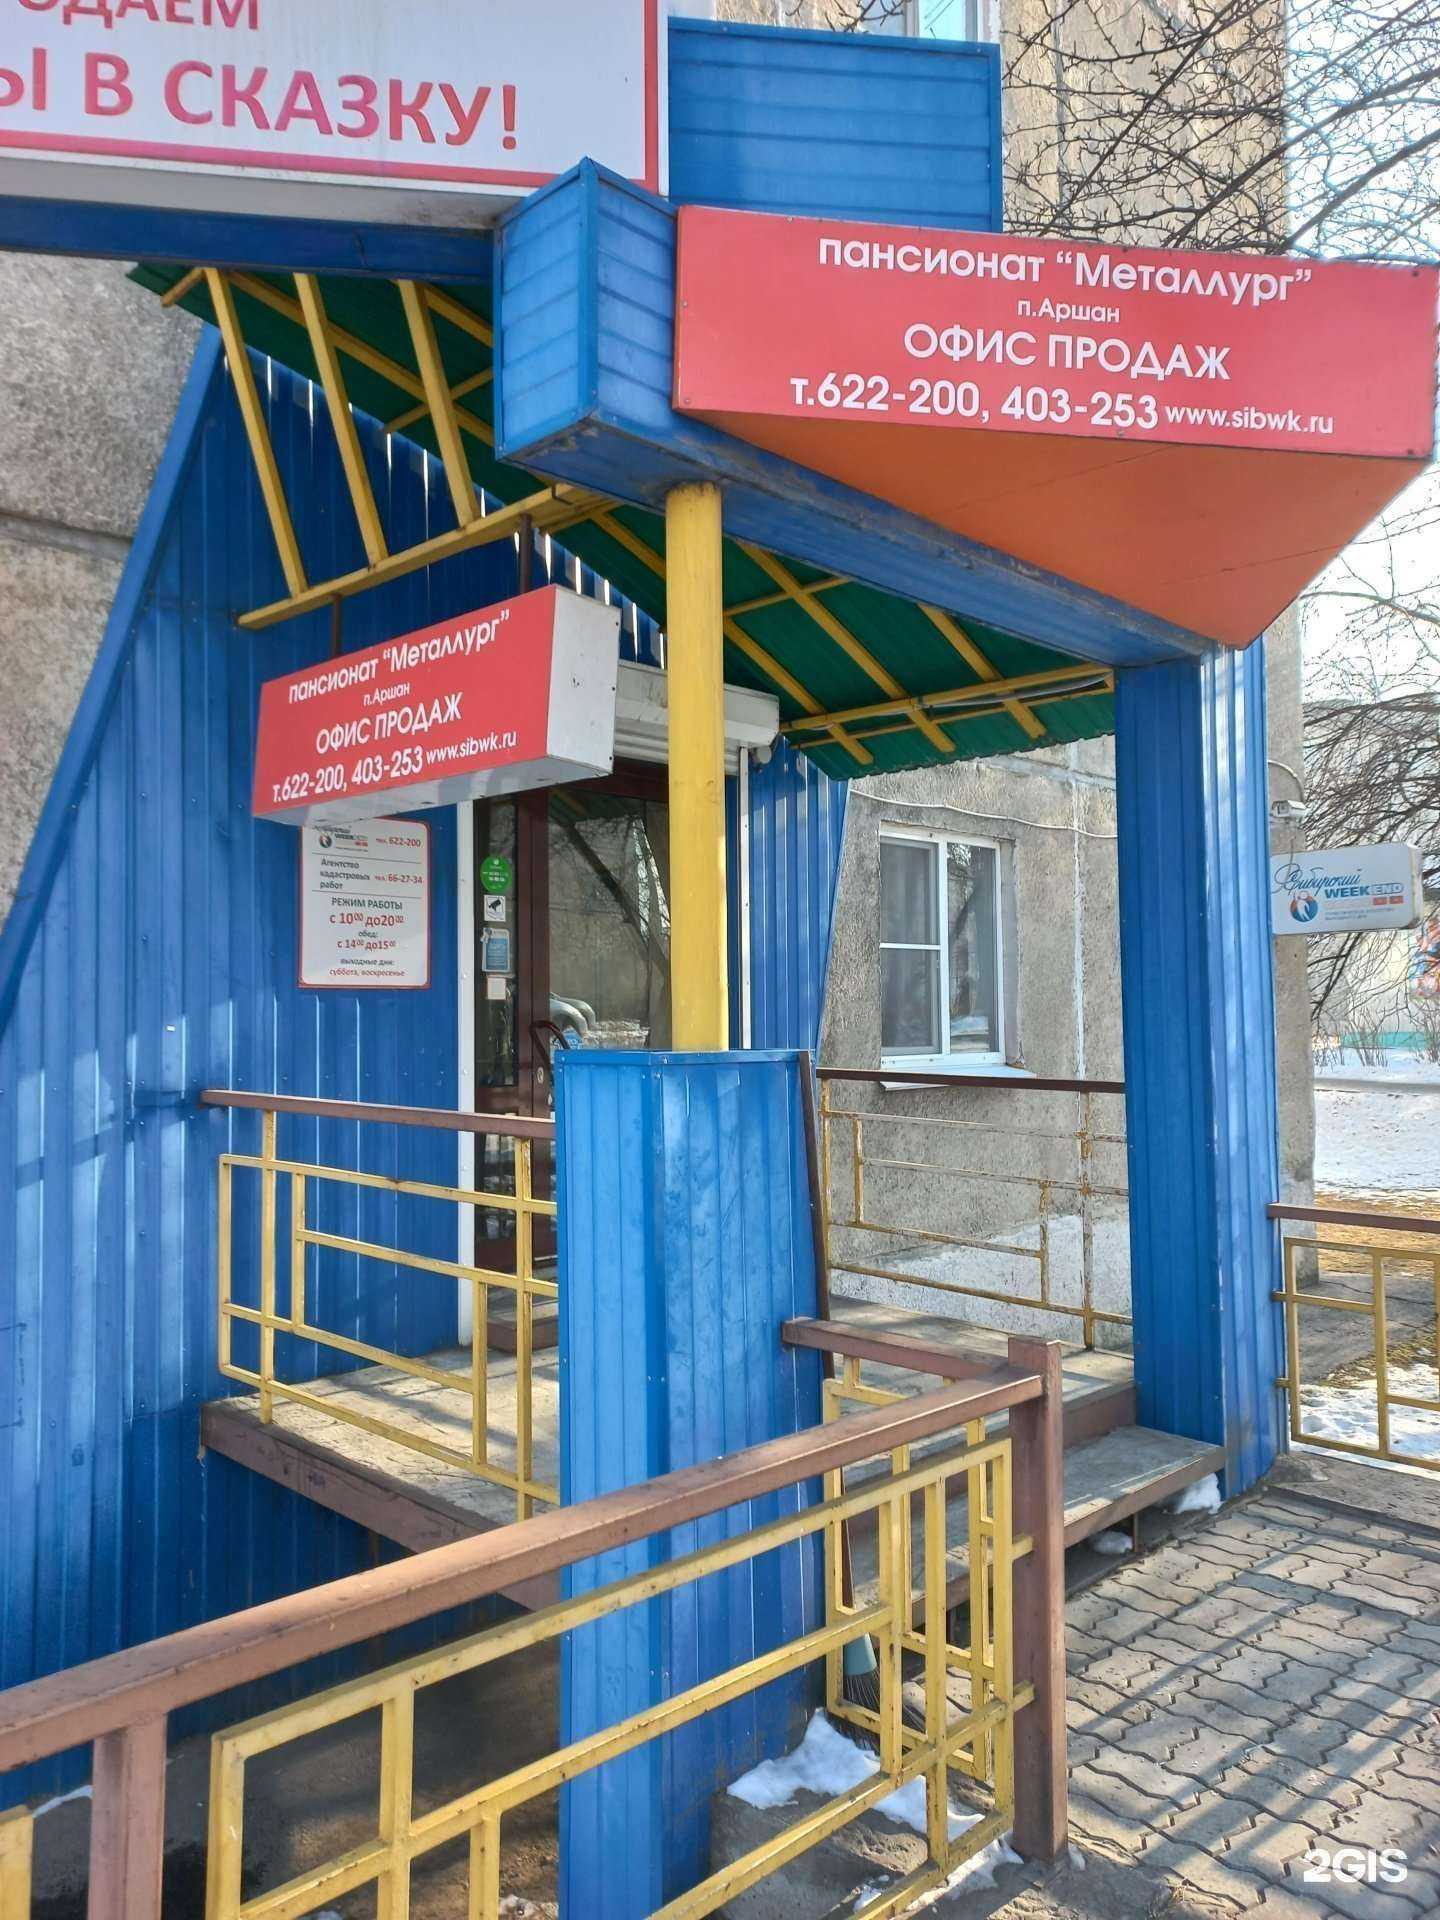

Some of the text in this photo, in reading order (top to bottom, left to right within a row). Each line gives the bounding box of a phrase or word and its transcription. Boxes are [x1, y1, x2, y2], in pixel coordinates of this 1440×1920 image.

[84, 52, 134, 117] В
[164, 60, 518, 151] СКАЗКУ!
[818, 237, 1046, 283] пансионат
[1017, 297, 1120, 323] п.Аршан
[904, 323, 1231, 382] ОФИС ПРОДАЖ
[789, 372, 1334, 435] т.622-200, 403-253 www.sibwk.ru
[288, 657, 379, 705] пансионат
[363, 681, 411, 707] п.Аршан
[315, 691, 463, 755] ОФИС ПРОДАЖ
[272, 729, 517, 804] т.622-200, 403-253 www.sibwk.ru
[389, 836, 421, 848] 622-200
[320, 870, 370, 881] кадастровых
[388, 873, 423, 885] 66-27-34
[321, 858, 360, 869] Агентство
[320, 881, 343, 889] работ
[331, 897, 403, 910] РЕЖИМ РАБОТЫ
